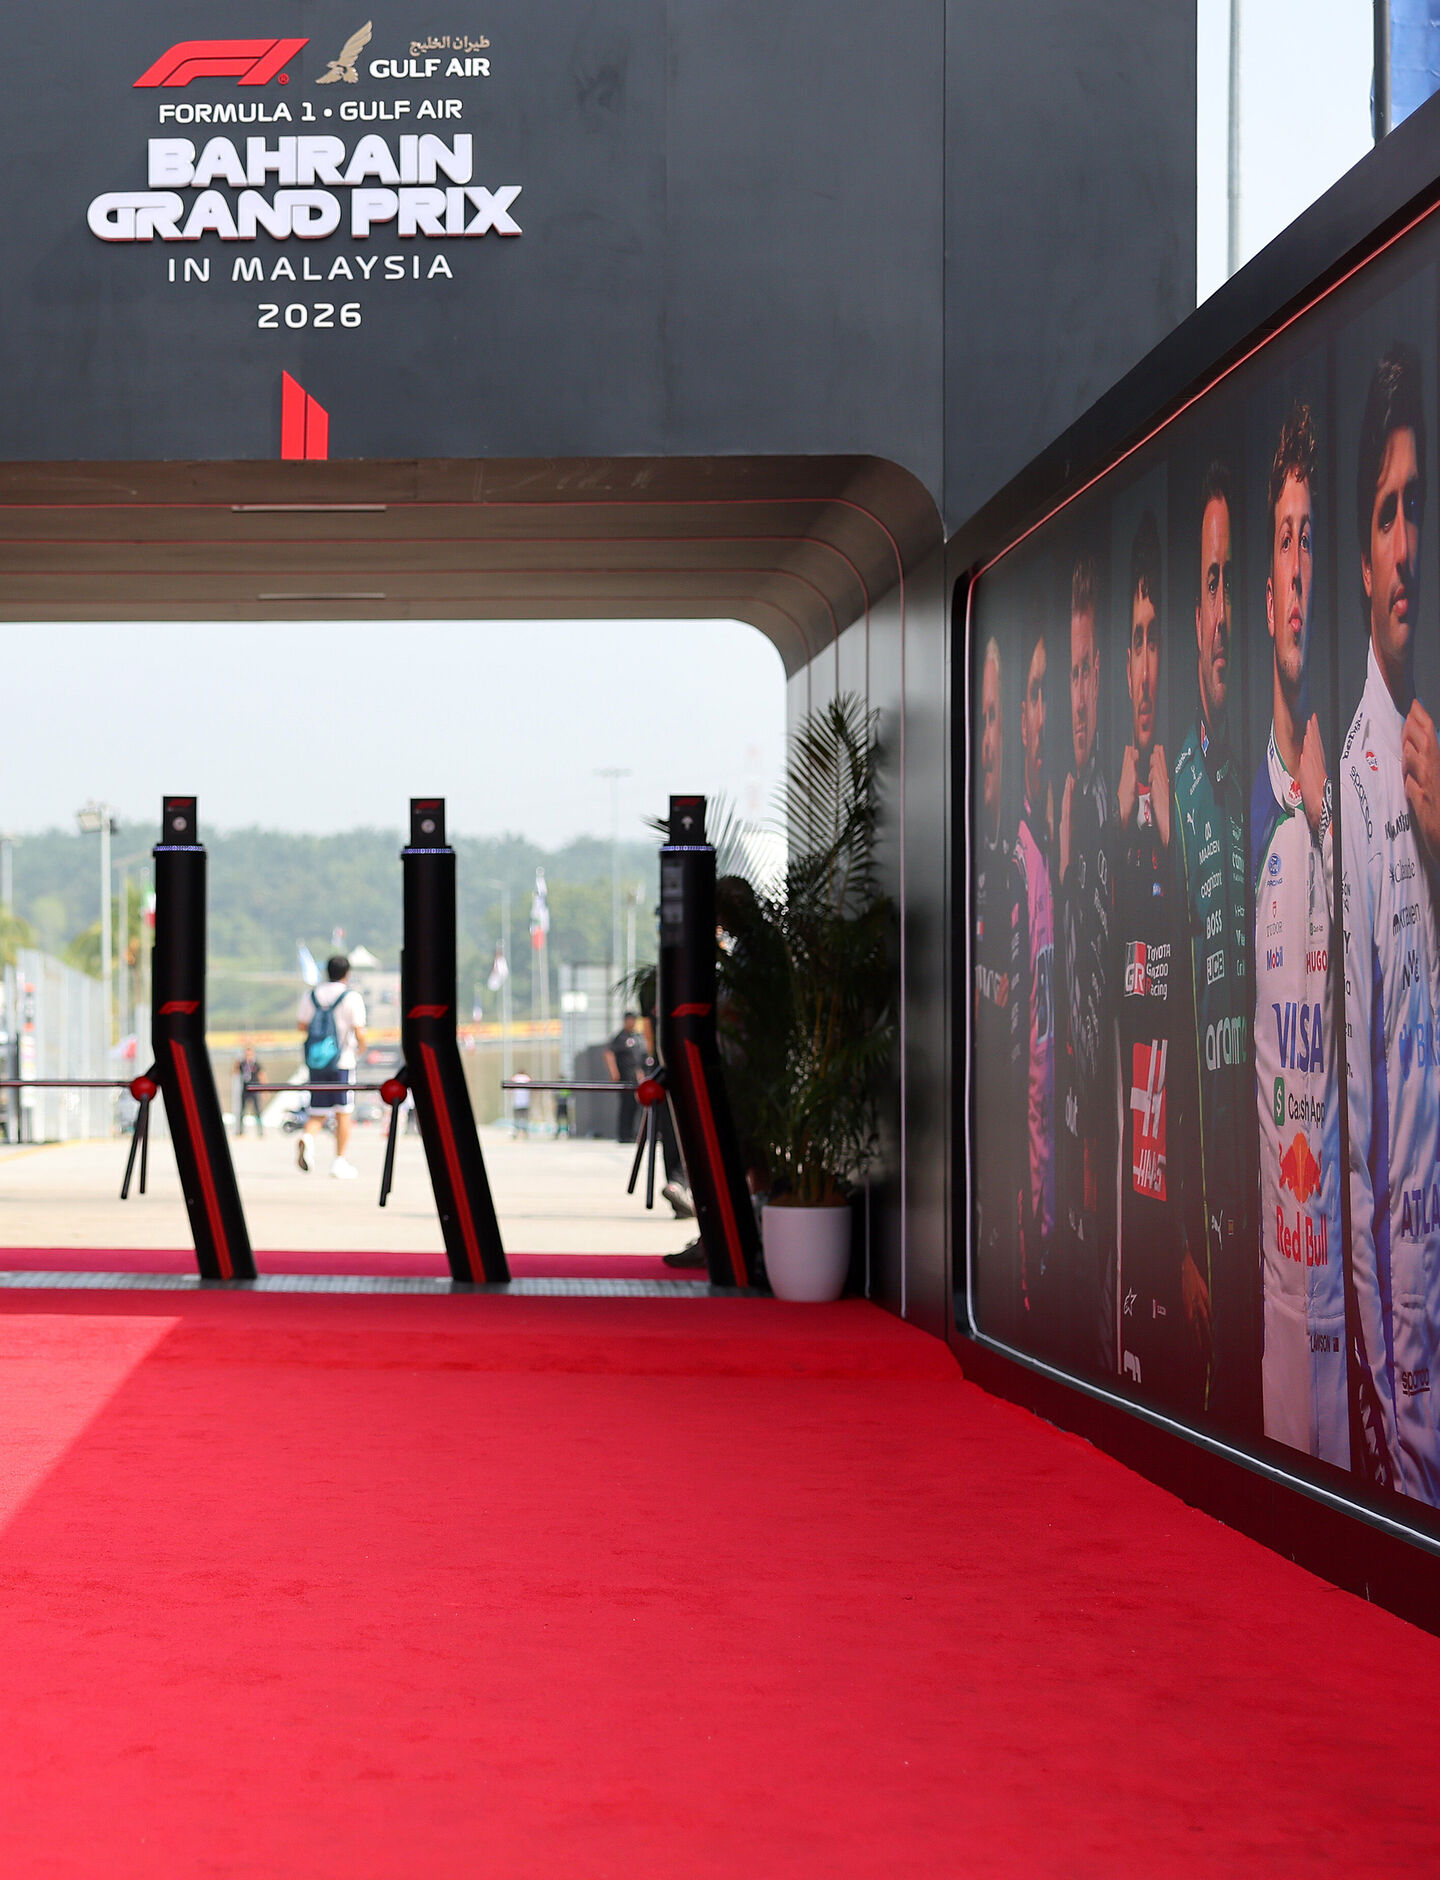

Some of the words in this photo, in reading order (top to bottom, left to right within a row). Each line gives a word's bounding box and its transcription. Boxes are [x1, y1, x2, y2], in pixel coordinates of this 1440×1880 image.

[369, 59, 438, 79] GULF
[445, 58, 491, 77] AIR
[159, 102, 292, 124] FORMULA
[300, 102, 317, 122] 1
[339, 101, 410, 121] GULF
[417, 99, 463, 119] AIR
[148, 134, 472, 188] BAHRAIN
[87, 189, 341, 241] GRAND
[351, 185, 523, 238] PRIX
[168, 258, 210, 282] IN
[232, 255, 453, 281] MALAYSIA
[257, 302, 362, 328] 2026
[1206, 908, 1223, 940] BOSS
[1147, 944, 1171, 962] TOYOTA
[1266, 946, 1283, 971] Mobil
[1306, 950, 1328, 975] HUGO
[1272, 1002, 1324, 1074] VISA
[1276, 1205, 1301, 1263] Red
[1306, 1212, 1328, 1266] Bull
